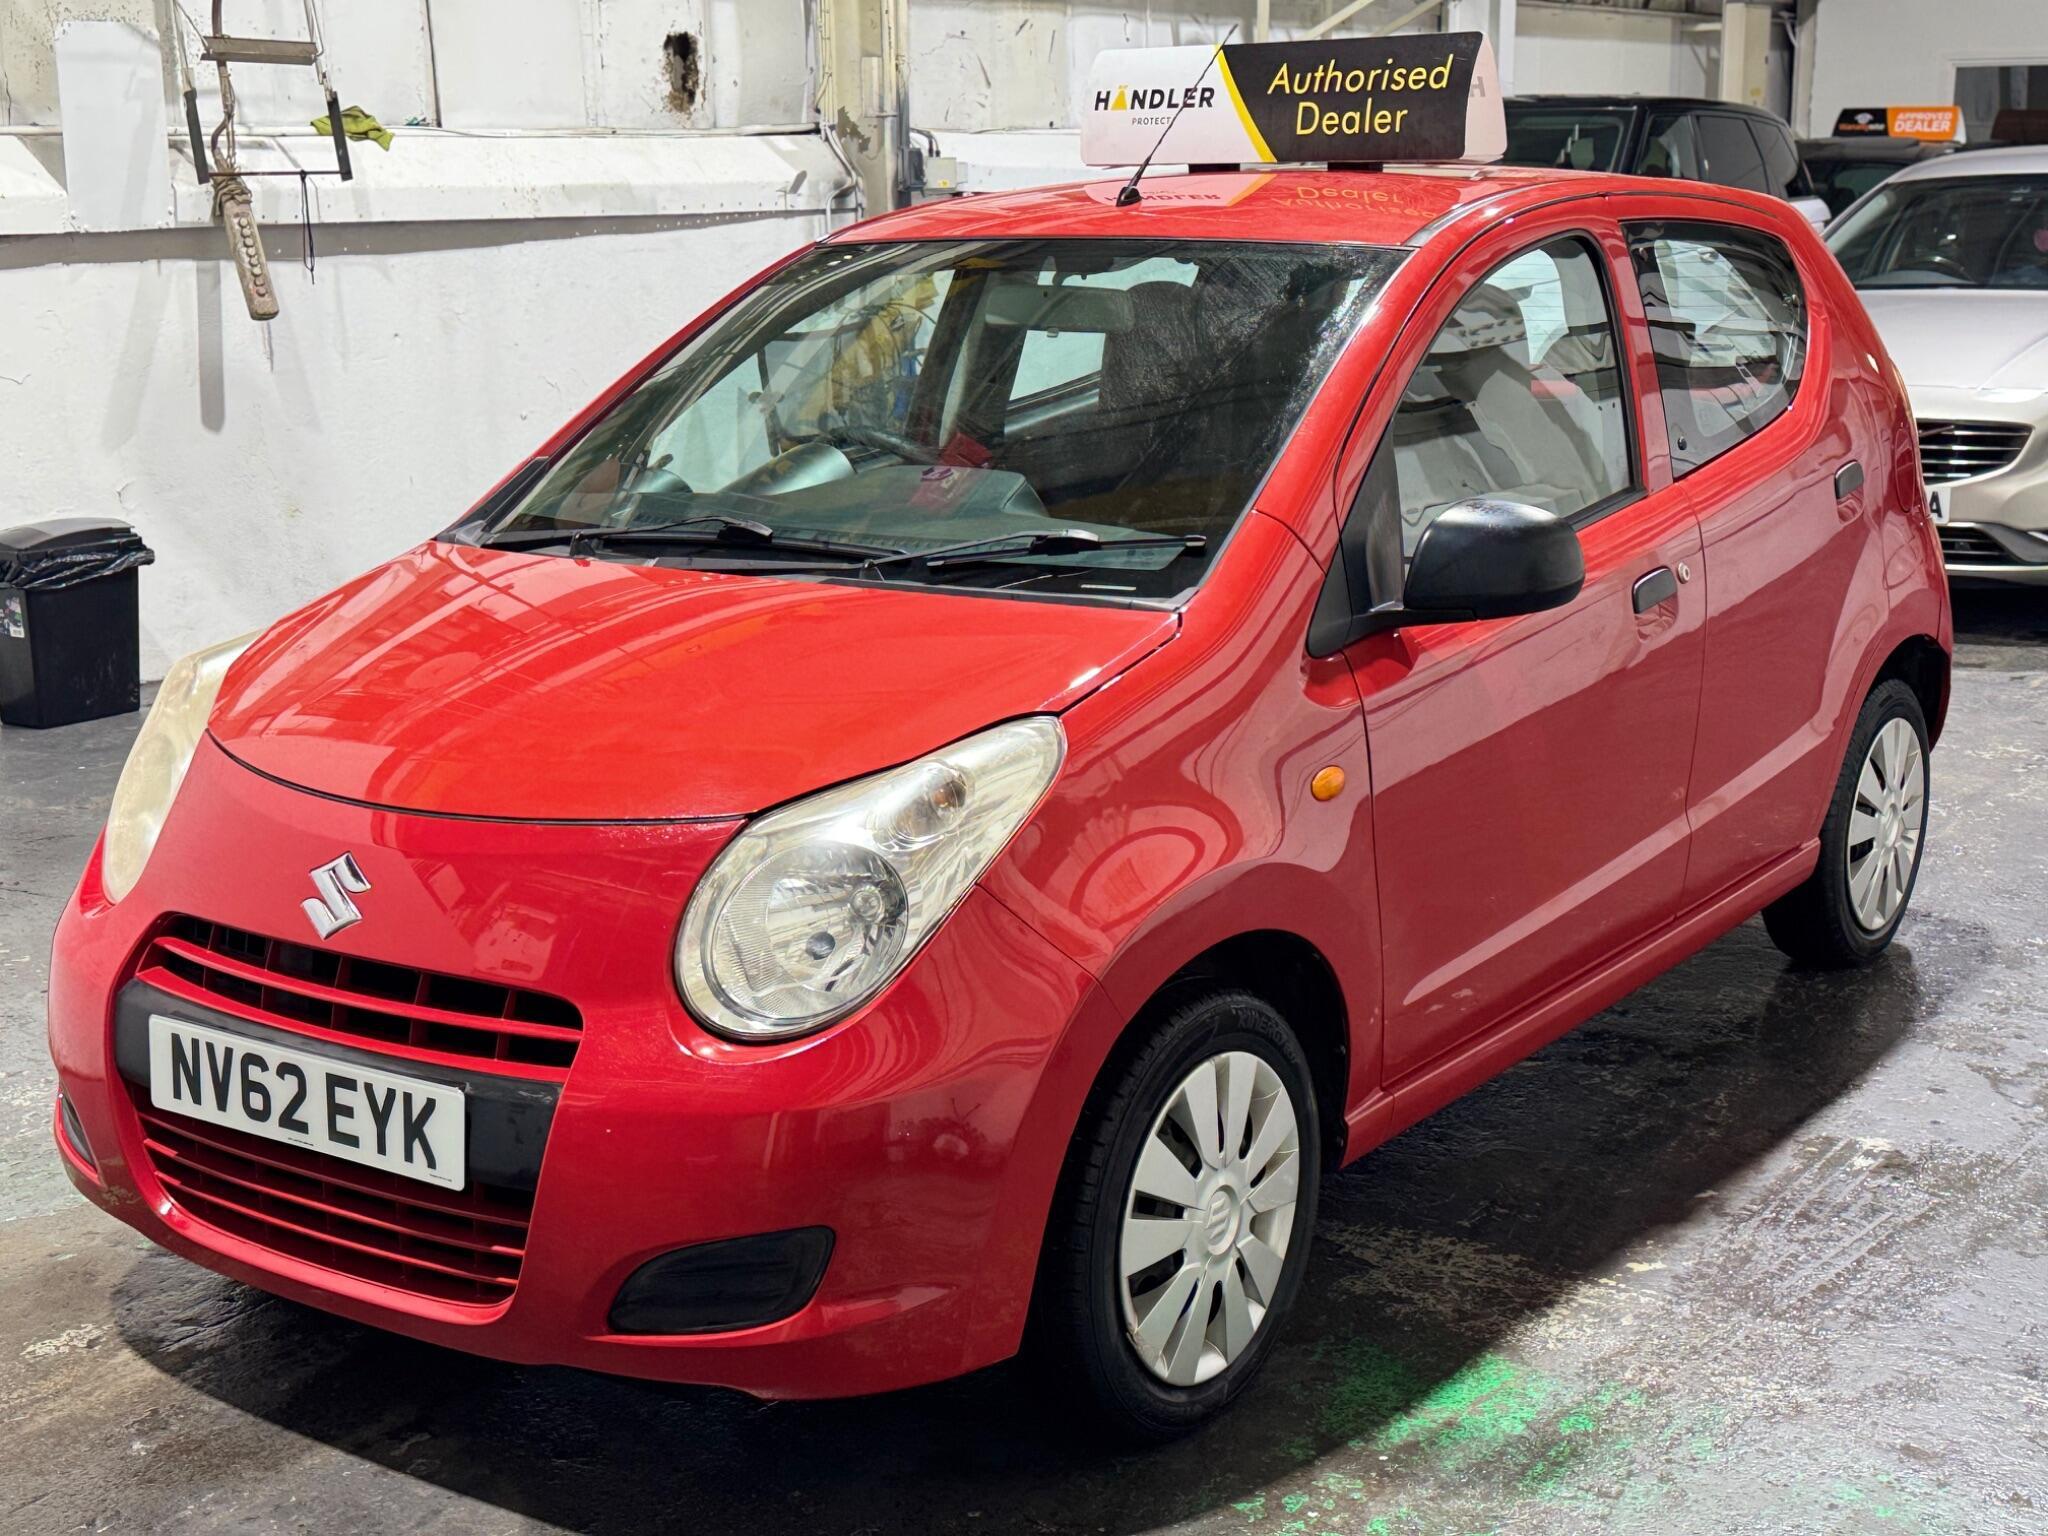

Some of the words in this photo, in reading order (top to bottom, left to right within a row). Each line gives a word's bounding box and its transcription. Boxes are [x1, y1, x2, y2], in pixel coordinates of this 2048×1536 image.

[1267, 54, 1454, 95] Authorised
[1131, 116, 1172, 126] PROTECT
[1296, 97, 1408, 135] Dealer
[1894, 120, 1951, 132] DEALER
[1897, 111, 1953, 120] APPROVED
[171, 1032, 309, 1135] NV62
[325, 1072, 437, 1170] EYK
